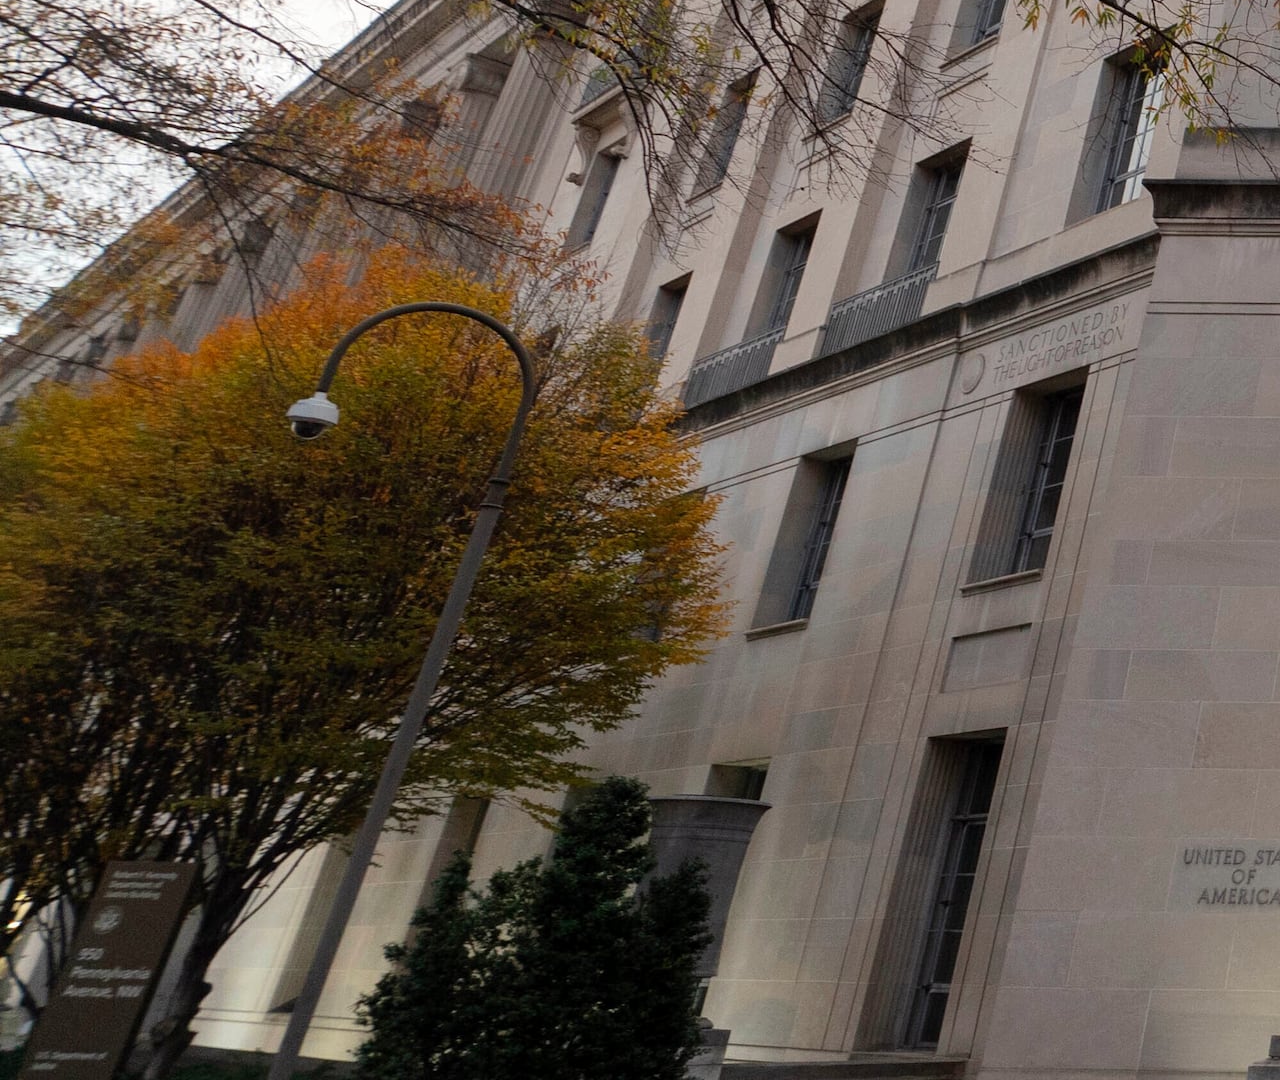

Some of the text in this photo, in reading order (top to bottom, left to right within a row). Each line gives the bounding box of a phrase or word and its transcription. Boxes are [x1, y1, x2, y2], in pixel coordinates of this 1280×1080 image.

[997, 301, 1132, 363] SANCTIONED BY
[1071, 325, 1126, 358] REASON
[1184, 849, 1246, 865] UNITED
[1231, 869, 1257, 885] OF
